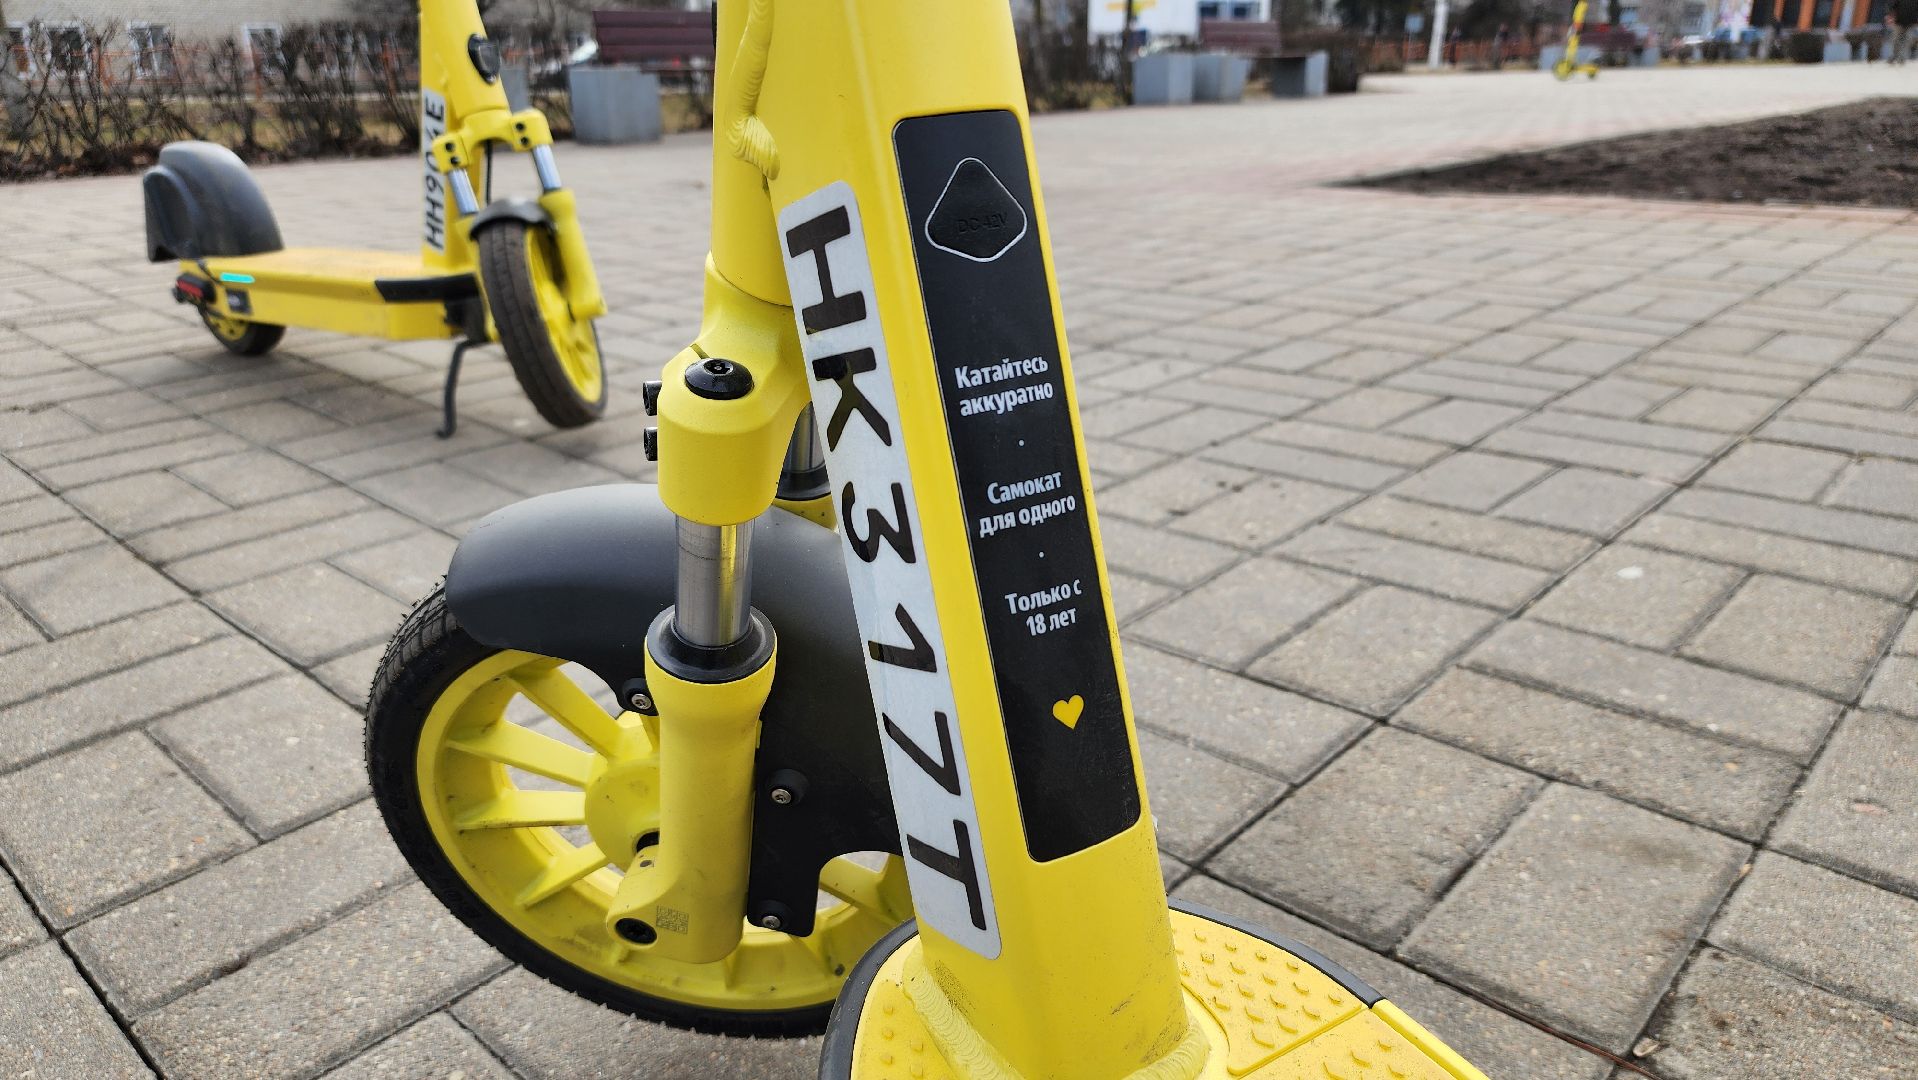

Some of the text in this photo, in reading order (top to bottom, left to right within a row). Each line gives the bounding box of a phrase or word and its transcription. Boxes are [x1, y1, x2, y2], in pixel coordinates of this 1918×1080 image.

[955, 357, 1048, 388] Катайтесь
[960, 383, 1054, 416] аккуратно
[987, 472, 1061, 504] Самокат
[979, 496, 1076, 538] для одного
[1005, 579, 1082, 614] Только с
[1026, 608, 1077, 636] 18 лет
